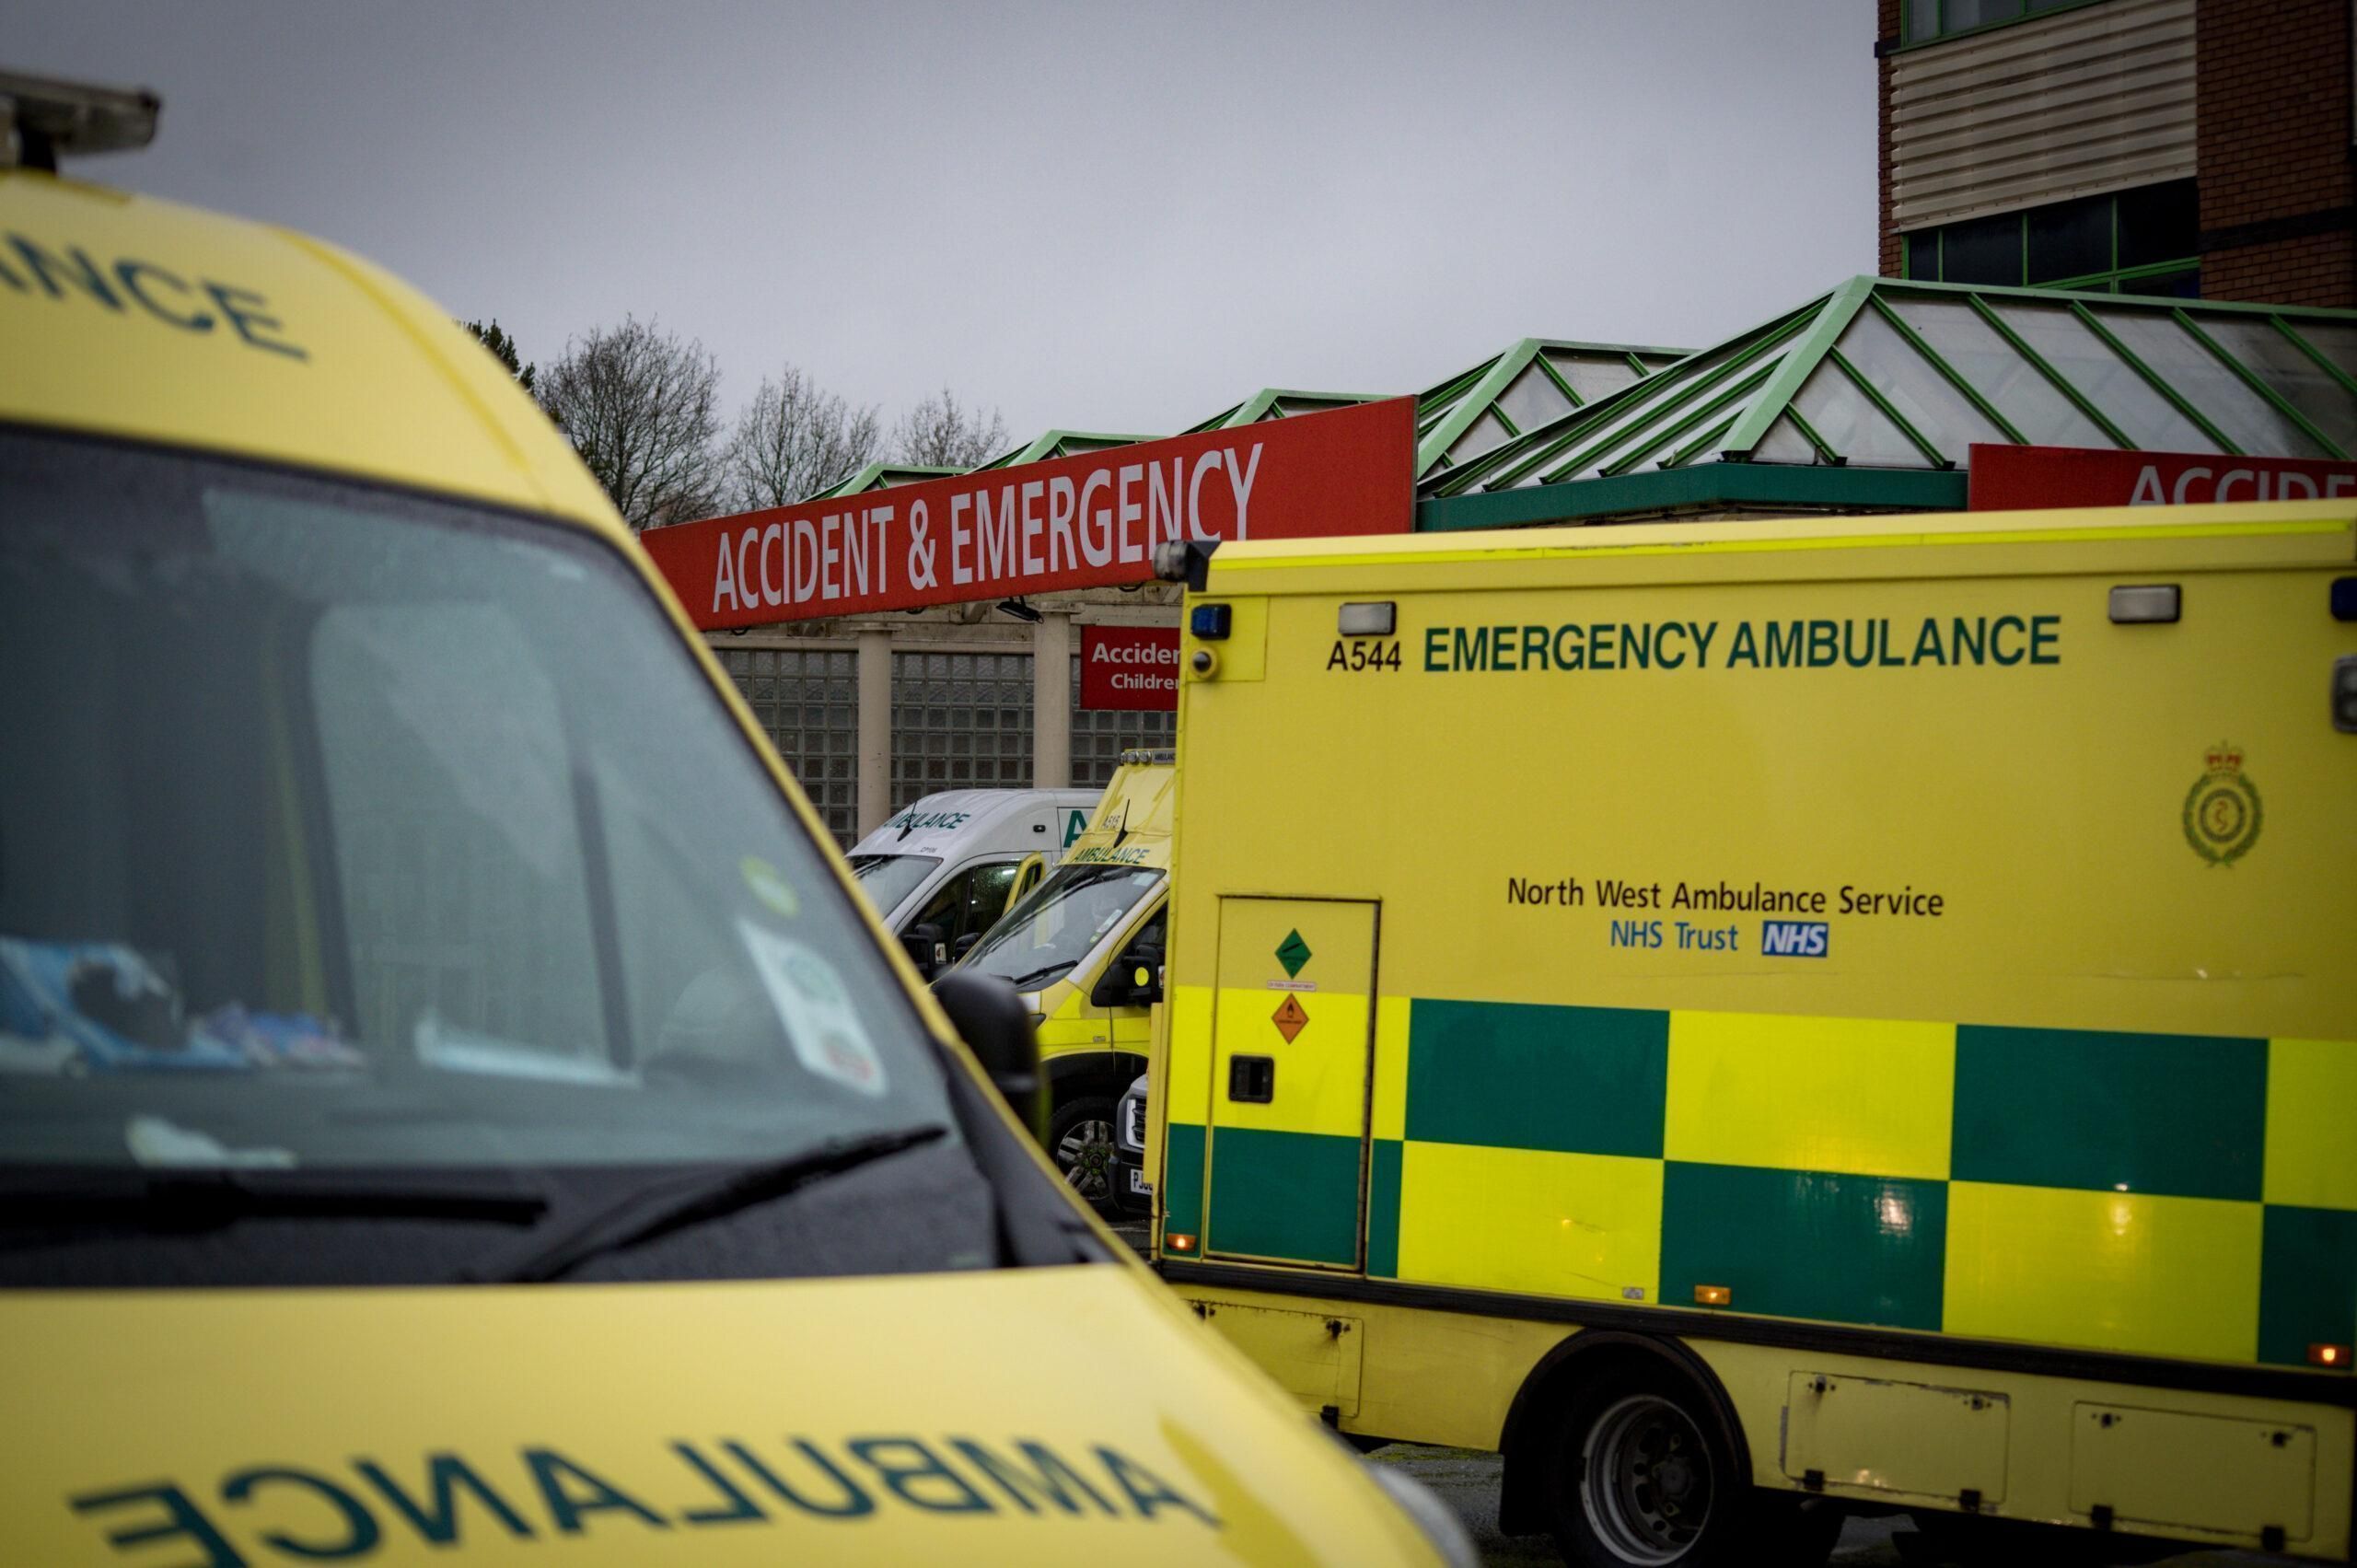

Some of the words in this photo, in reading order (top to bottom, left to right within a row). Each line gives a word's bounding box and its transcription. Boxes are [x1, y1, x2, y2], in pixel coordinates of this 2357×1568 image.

[0, 232, 310, 362] NCE
[713, 505, 895, 613] ACCIDENT
[908, 498, 938, 591] &
[950, 442, 1264, 587] EMERGENCY
[1327, 640, 1402, 672] A544
[1423, 621, 1719, 672] EMERGENCY
[1726, 614, 2061, 669] AMBULANCE
[1071, 846, 1151, 865] AMBULANCE
[1507, 877, 1585, 907] North
[1596, 879, 1662, 909] West
[1671, 881, 1827, 914] Ambulance
[1839, 885, 1945, 917] Service
[1610, 921, 1663, 949] NHS
[1674, 922, 1738, 951] Trust
[1762, 923, 1827, 956] NHS
